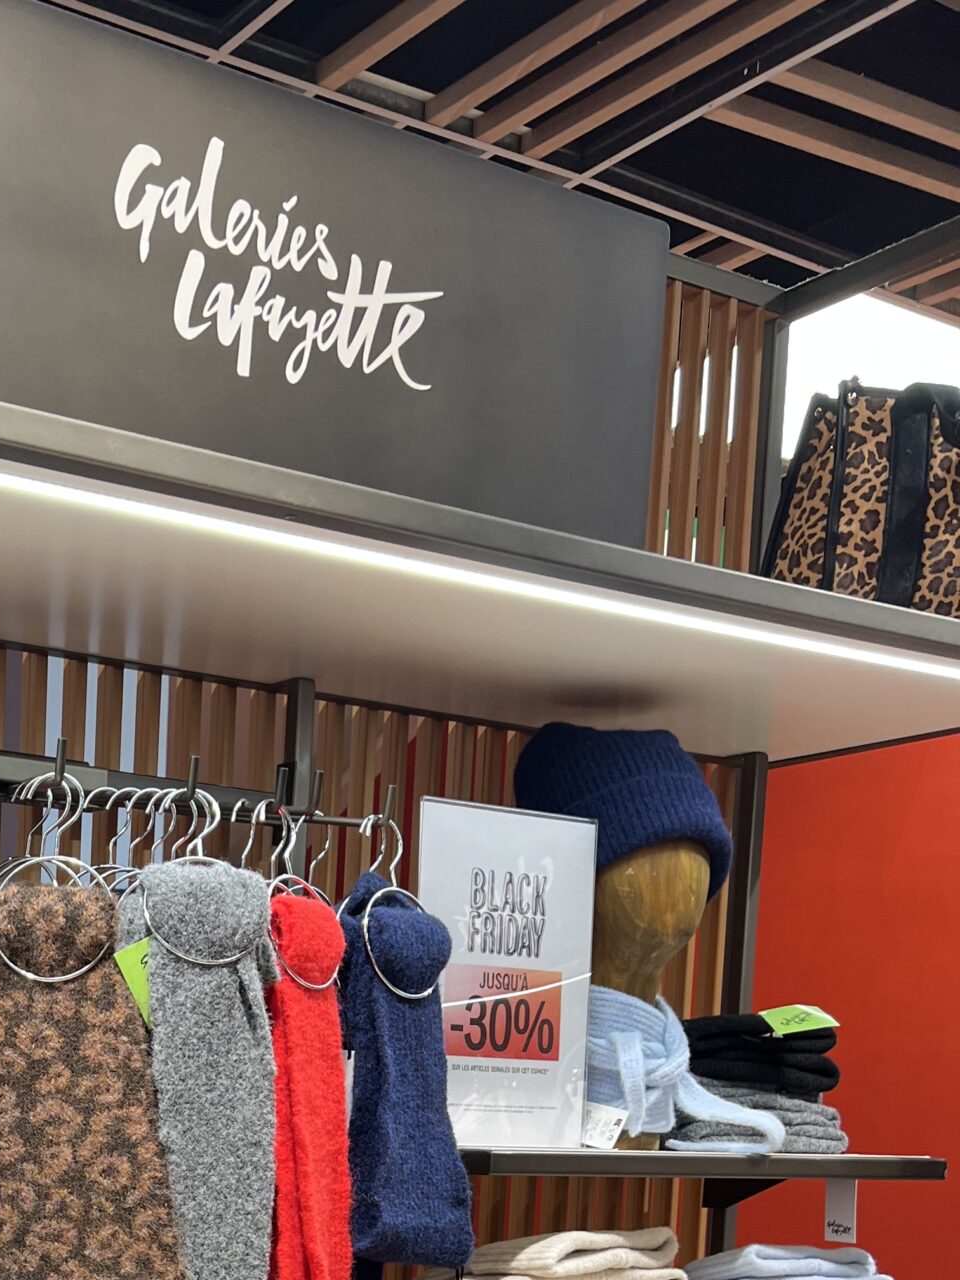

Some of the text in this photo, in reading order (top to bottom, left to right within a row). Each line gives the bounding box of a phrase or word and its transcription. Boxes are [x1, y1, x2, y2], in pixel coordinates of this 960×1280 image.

[114, 136, 338, 281] Galeries
[173, 249, 444, 390] Lafayette
[469, 866, 547, 917] BLACK
[467, 910, 545, 959] FRIDAY
[479, 971, 529, 991] JUSQU'À
[450, 995, 555, 1054] -30%
